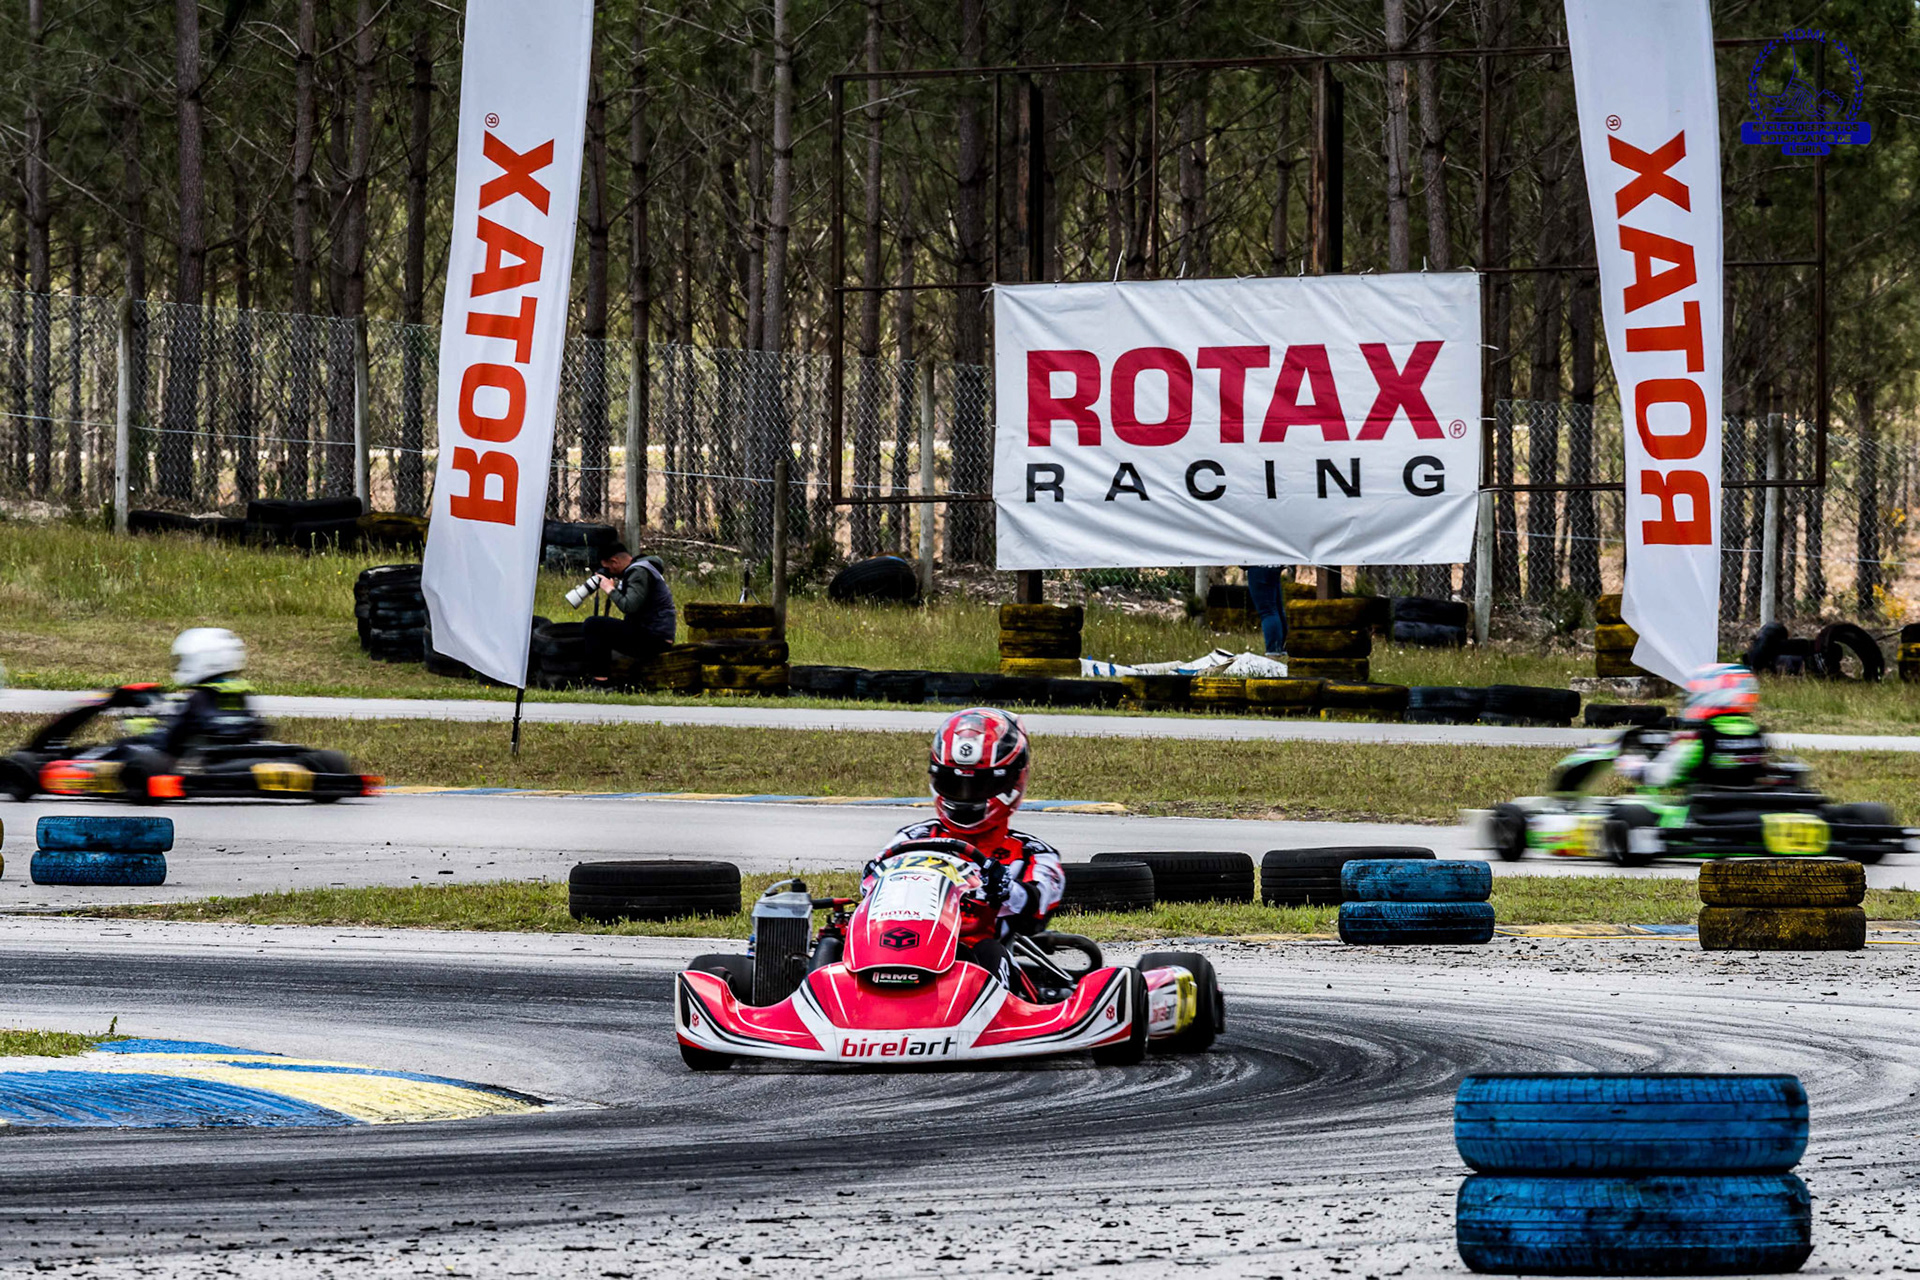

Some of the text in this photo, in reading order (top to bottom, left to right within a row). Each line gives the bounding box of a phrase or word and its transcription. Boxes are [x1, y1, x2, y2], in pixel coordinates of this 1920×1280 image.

[1027, 340, 1445, 447] ROTAX
[1026, 455, 1445, 503] RACING
[880, 973, 919, 981] RMC
[841, 1036, 957, 1058] birelart
